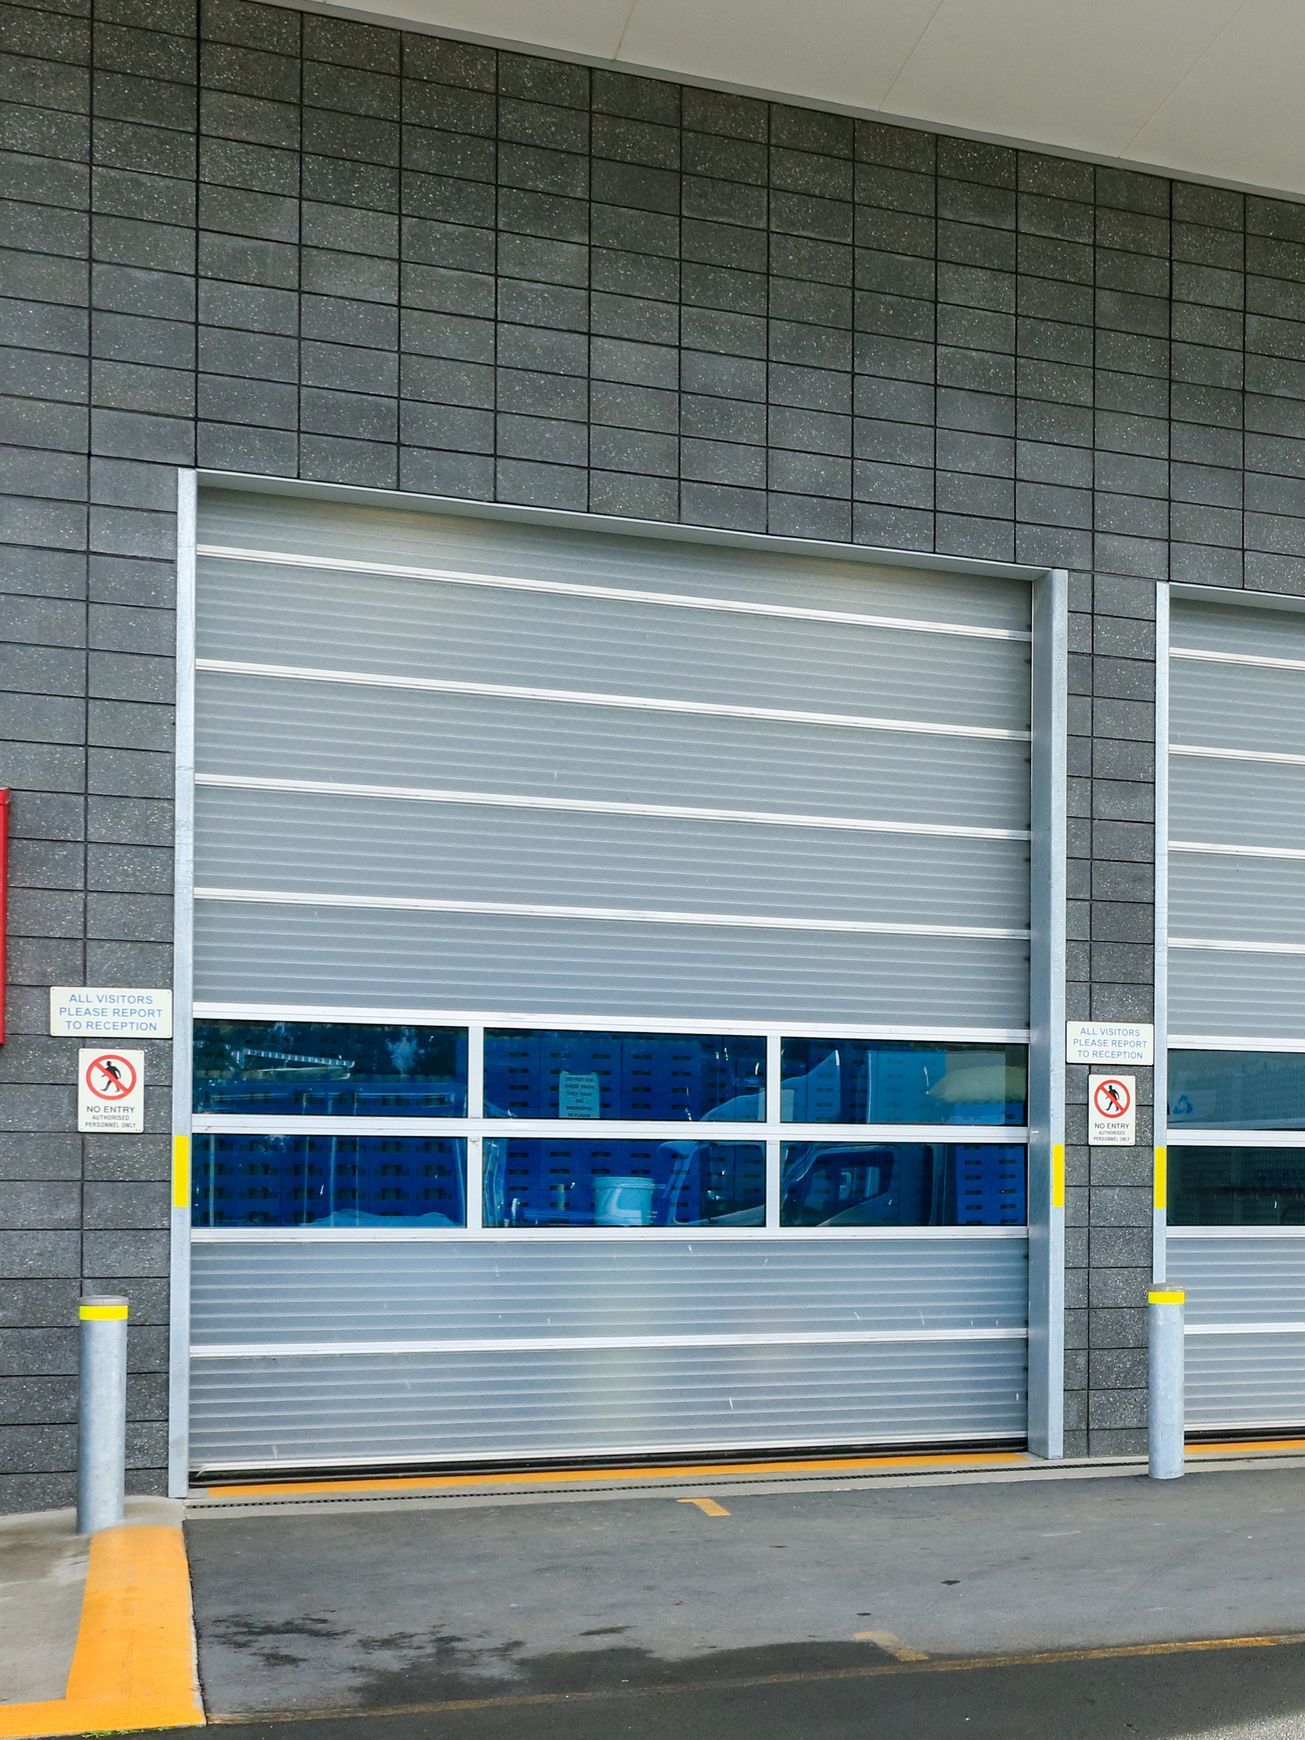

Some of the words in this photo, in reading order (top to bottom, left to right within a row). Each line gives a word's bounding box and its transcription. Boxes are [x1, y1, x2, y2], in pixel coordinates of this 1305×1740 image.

[69, 994, 93, 1003] ALL
[96, 994, 153, 1005] VISITORS
[59, 1007, 108, 1017] PLEASE
[112, 1008, 164, 1018] REPORT
[65, 1021, 82, 1030] TO
[86, 1021, 157, 1031] RECEPTION
[1080, 1027, 1097, 1036] ALL
[1100, 1028, 1140, 1037] VISITORS
[1073, 1038, 1109, 1047] PLEASE
[1111, 1040, 1148, 1049] REPORT
[1077, 1050, 1090, 1058] TO
[1092, 1050, 1143, 1059] RECEPTION
